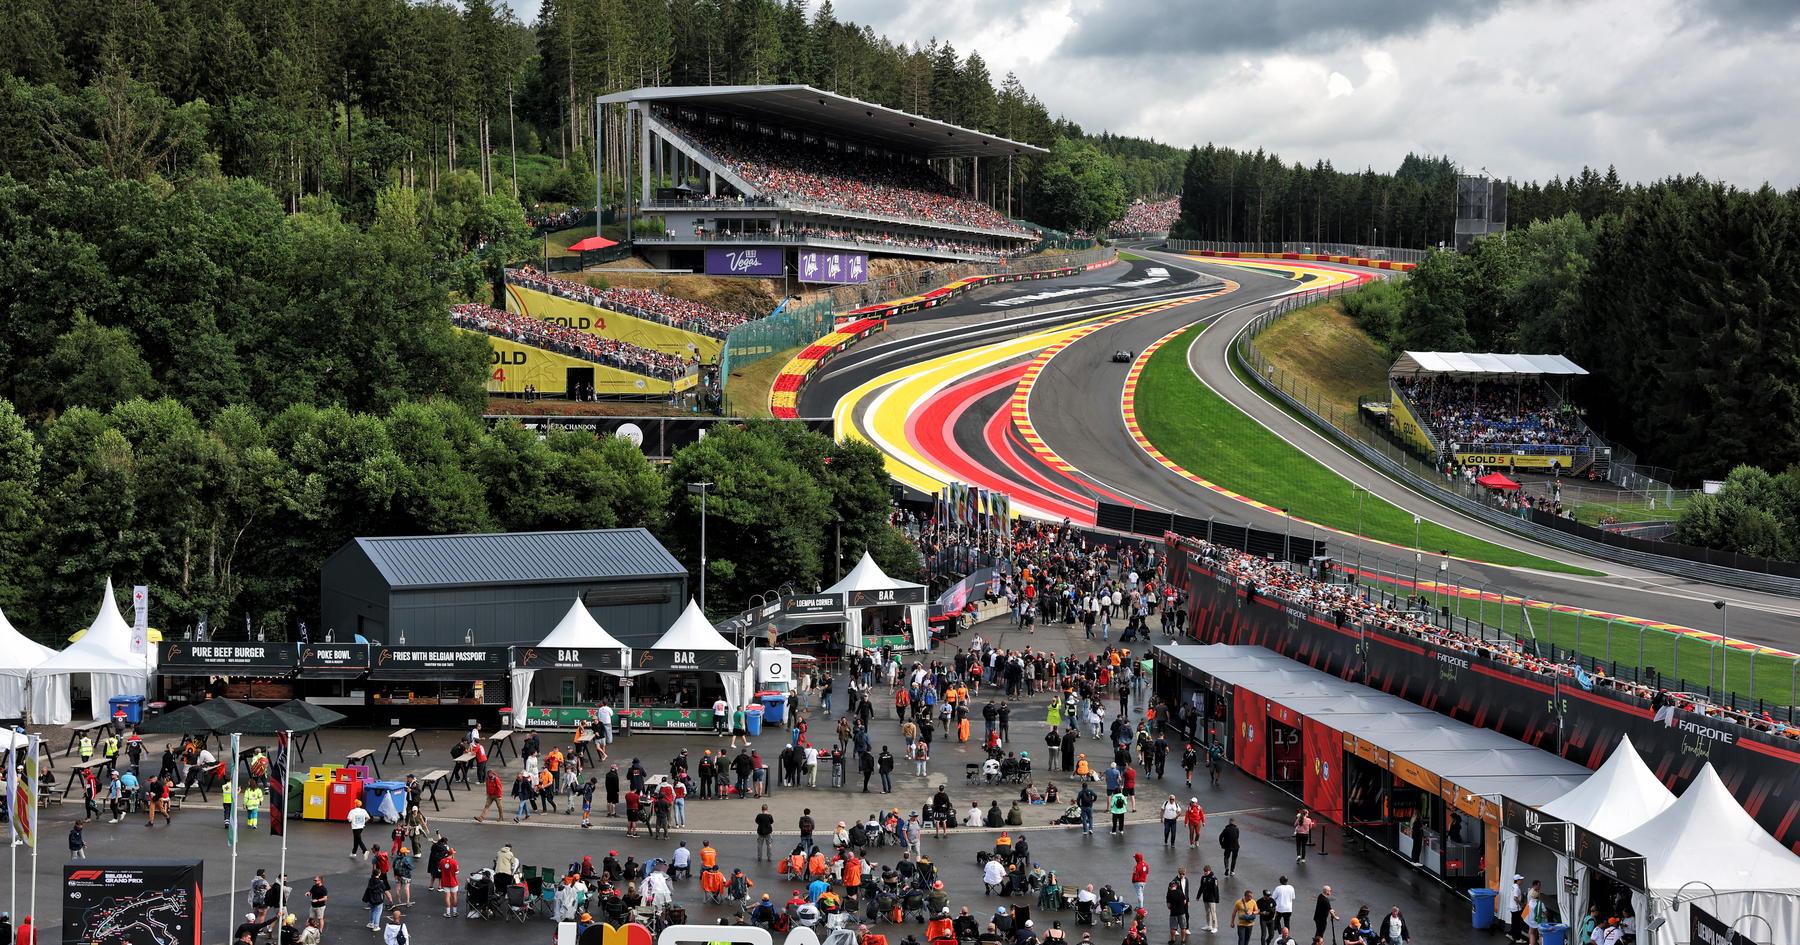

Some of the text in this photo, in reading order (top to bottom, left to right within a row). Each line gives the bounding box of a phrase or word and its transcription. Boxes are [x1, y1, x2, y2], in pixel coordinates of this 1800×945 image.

[726, 251, 762, 272] Vegas
[594, 317, 606, 330] 4
[490, 351, 527, 364] OLD
[491, 368, 506, 382] 4
[879, 591, 894, 601] BAR
[796, 598, 833, 608] LOEMPIA CORNER
[1286, 607, 1307, 620] FANZONE
[192, 647, 265, 658] PURE BEEF BURGER
[317, 650, 351, 659] POKE BOWL
[1356, 643, 1360, 654] G
[393, 652, 486, 661] FRIES WITH BELGIAN PASSPORT
[558, 650, 579, 662] BAR
[674, 652, 695, 664] BAR
[1437, 653, 1468, 669] FANZONE
[1547, 701, 1553, 714] F
[1563, 699, 1567, 712] E
[1679, 720, 1732, 744] FANZONE
[1525, 810, 1541, 832] BAR
[1600, 841, 1614, 867] BAR
[68, 870, 104, 880] F1
